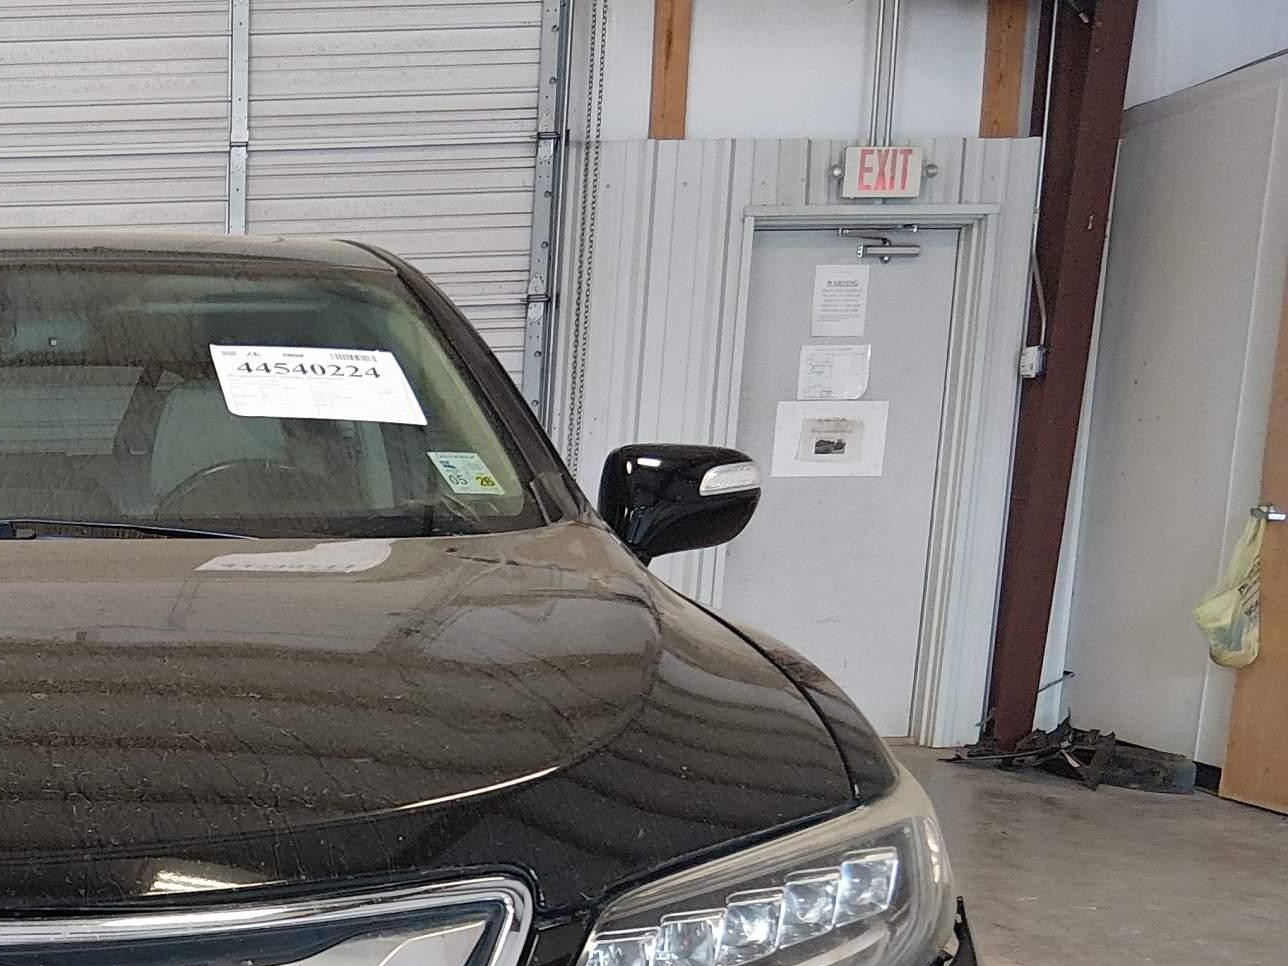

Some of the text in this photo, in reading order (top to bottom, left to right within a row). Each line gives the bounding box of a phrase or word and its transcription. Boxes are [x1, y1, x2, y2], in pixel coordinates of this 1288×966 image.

[857, 149, 913, 191] EXIT
[236, 362, 381, 378] 44540224
[448, 474, 468, 486] 05
